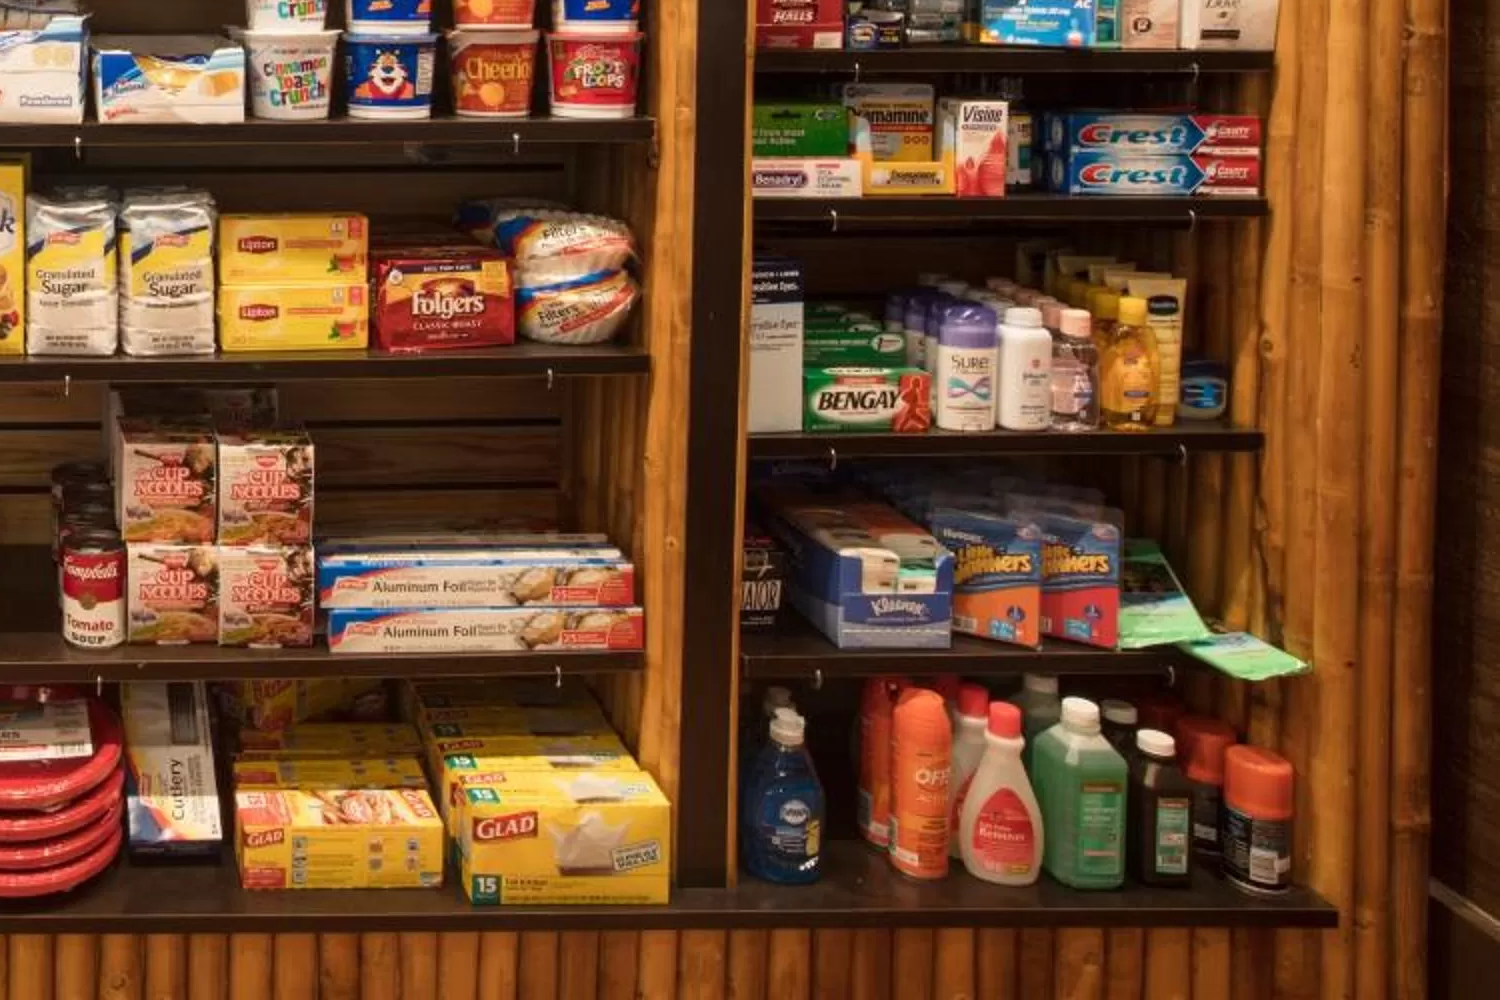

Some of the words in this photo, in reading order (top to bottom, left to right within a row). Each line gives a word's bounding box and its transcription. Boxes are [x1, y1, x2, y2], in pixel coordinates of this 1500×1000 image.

[1078, 122, 1188, 147] Crest
[1078, 162, 1188, 186] Crest
[41, 279, 88, 297] Sugar
[149, 281, 197, 298] Sugar
[411, 290, 485, 319] Folgers
[818, 390, 901, 411] BENGAY
[383, 626, 449, 638] Aluminum
[171, 759, 185, 822] Cutlery
[476, 816, 535, 840] GLAD
[477, 877, 497, 893] 15
